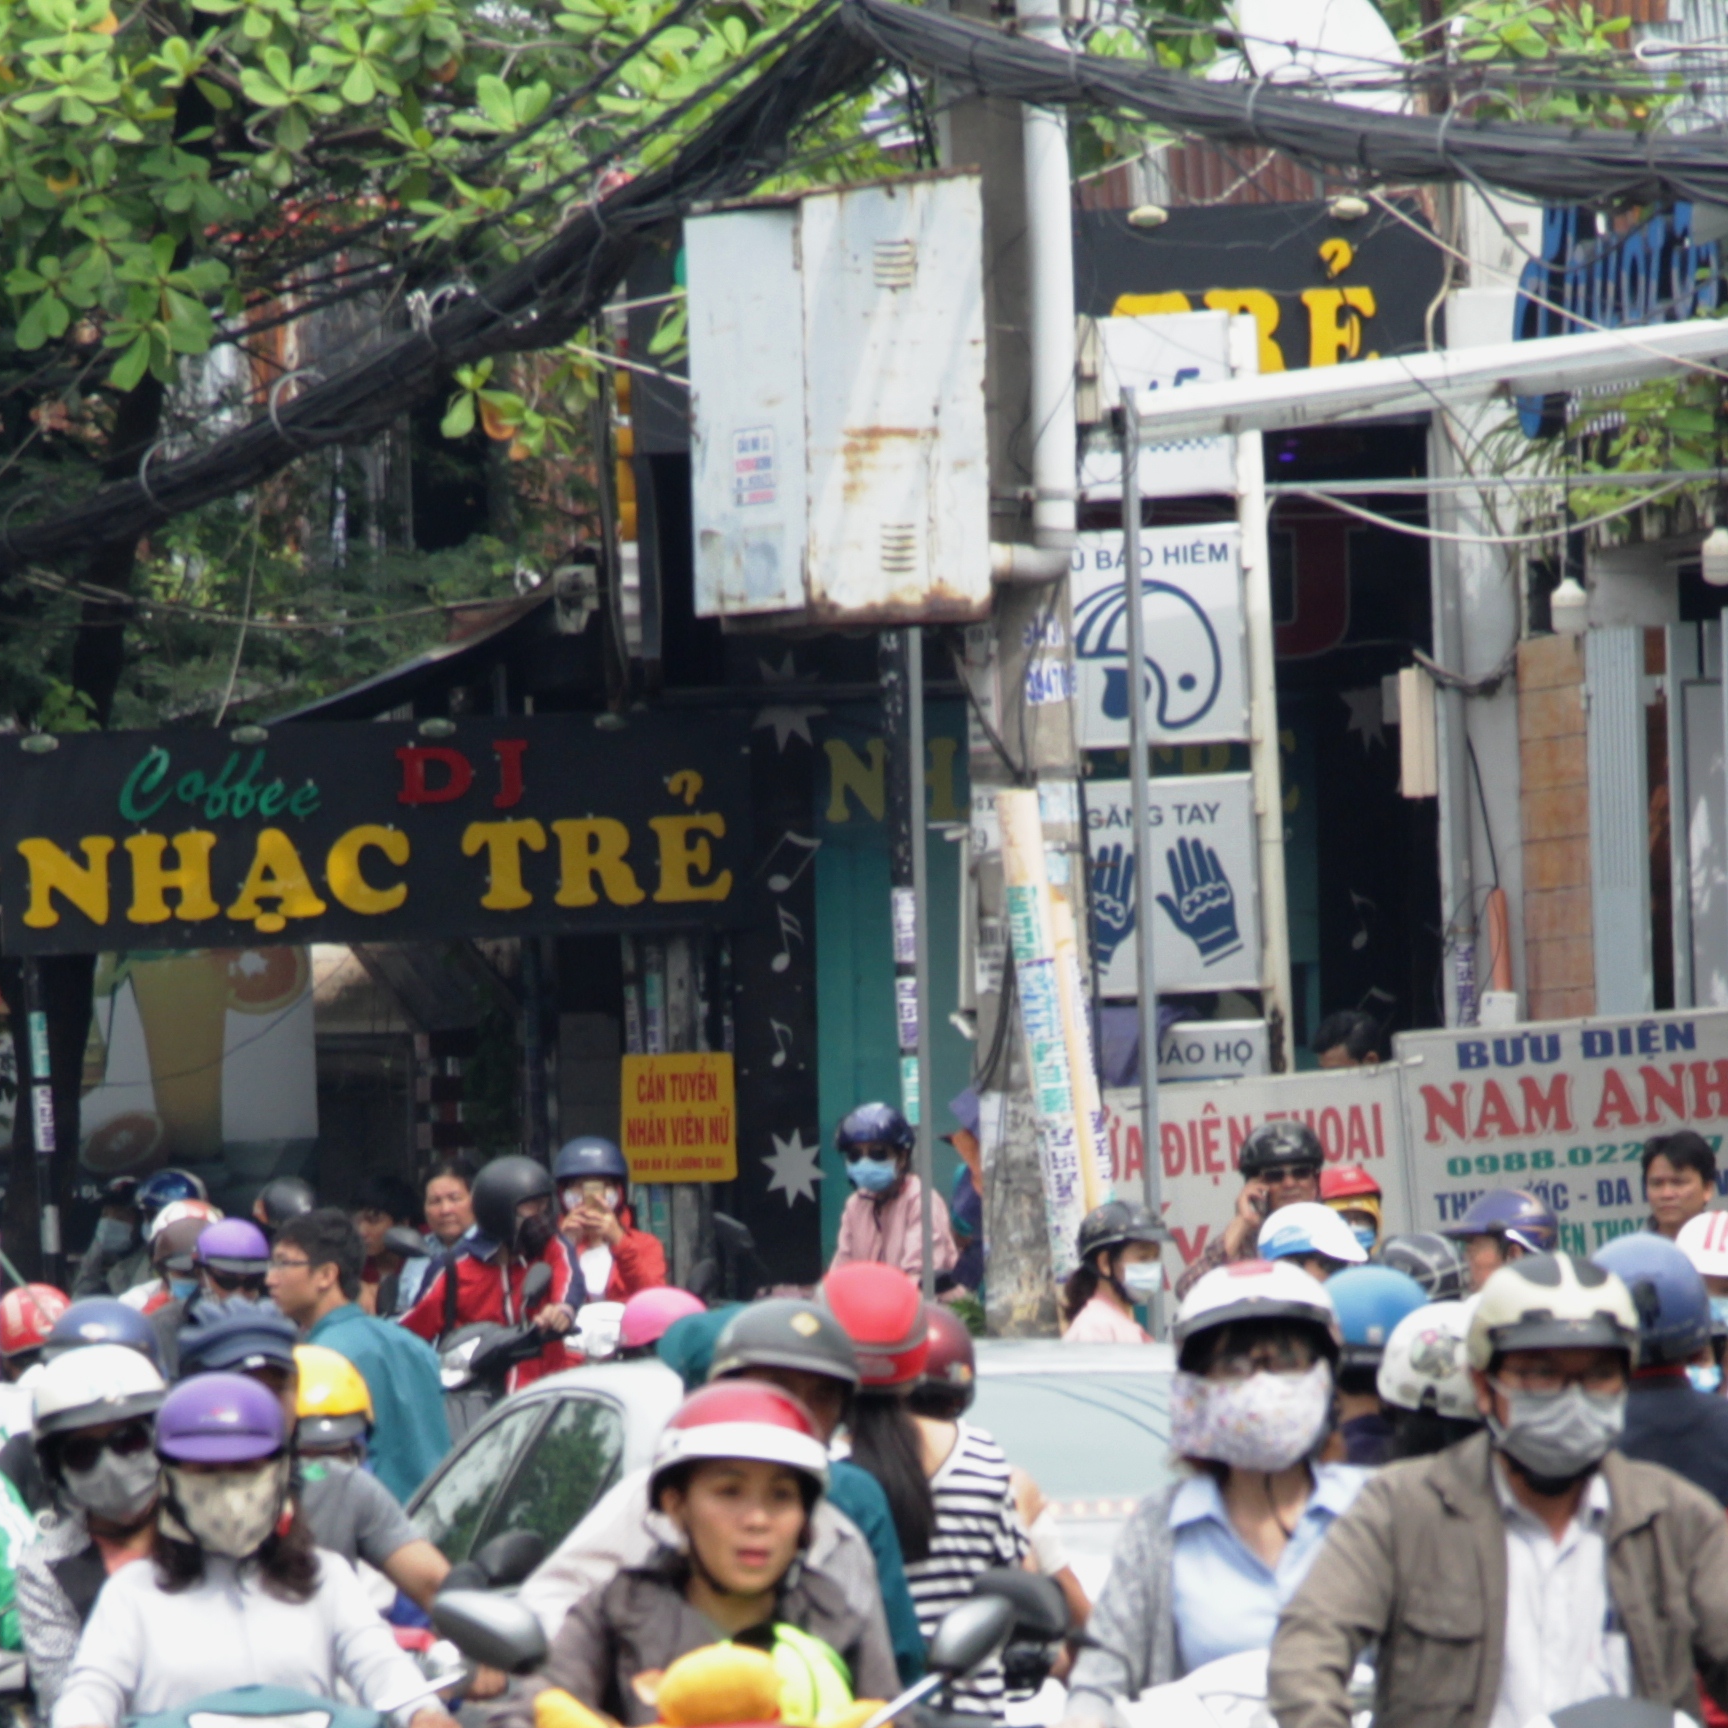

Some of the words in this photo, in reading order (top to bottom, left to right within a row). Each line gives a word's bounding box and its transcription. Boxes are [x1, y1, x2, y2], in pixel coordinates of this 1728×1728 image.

[119, 747, 321, 822] Coffee
[1173, 803, 1221, 825] TAY
[17, 824, 410, 933] NHẠC
[461, 769, 733, 910] TRẺ
[1213, 1040, 1254, 1068] HỘ
[1457, 1031, 1562, 1071] BƯU
[1581, 1019, 1697, 1061] ĐIỆN
[1420, 1072, 1578, 1147] NAM
[1597, 1178, 1633, 1208] ĐA
